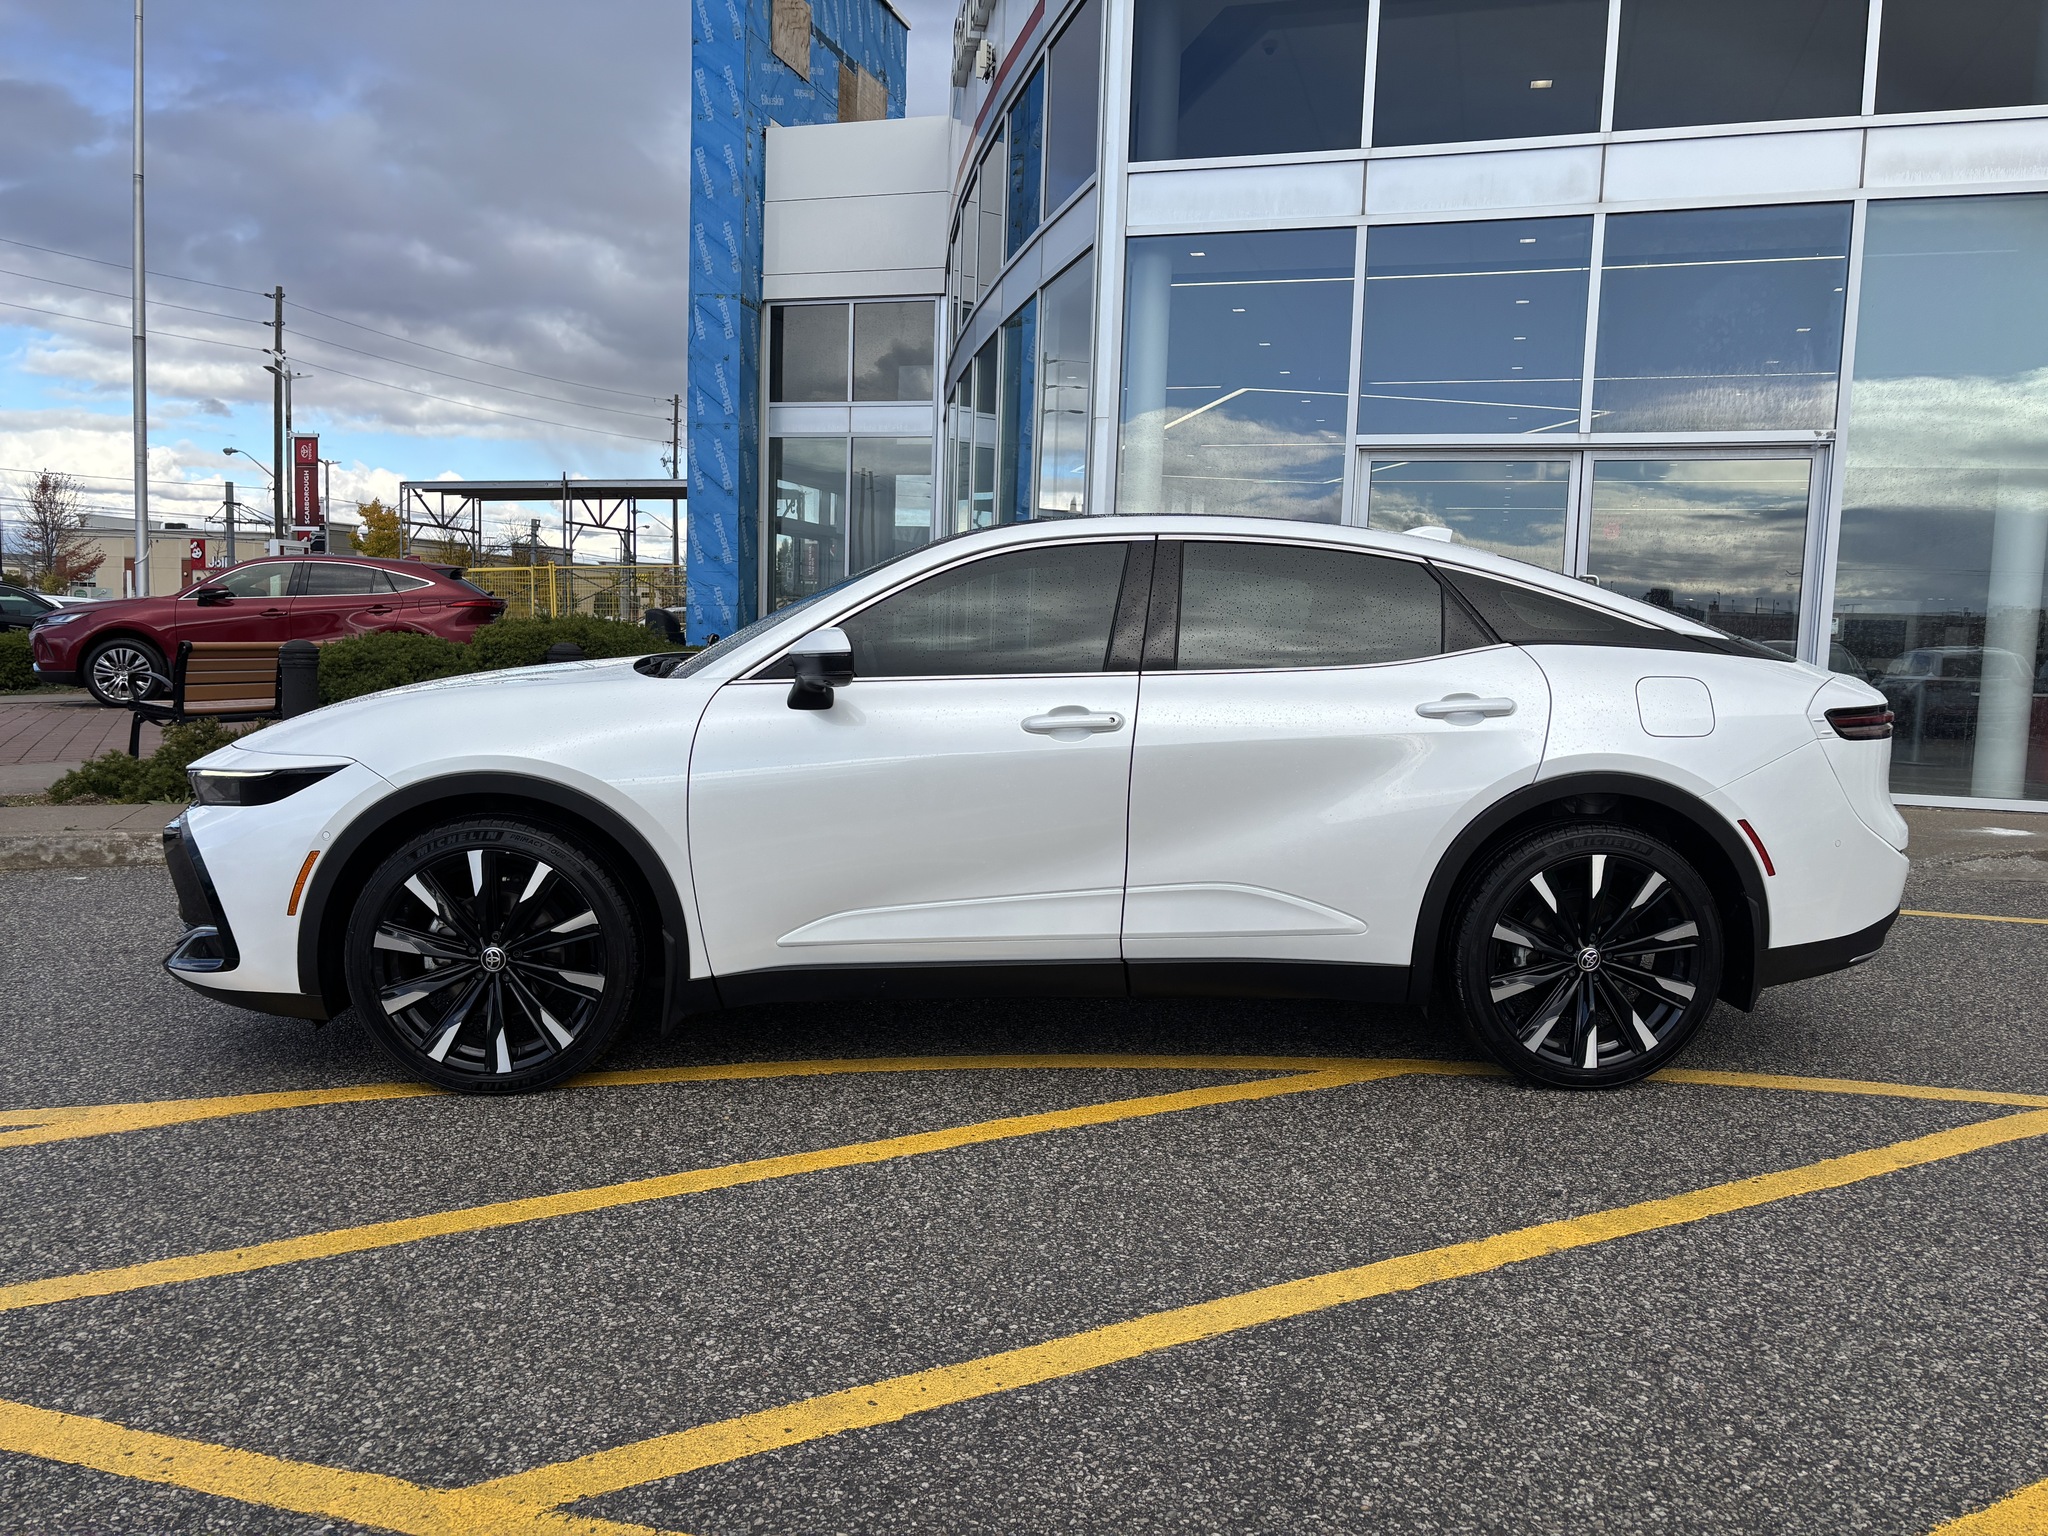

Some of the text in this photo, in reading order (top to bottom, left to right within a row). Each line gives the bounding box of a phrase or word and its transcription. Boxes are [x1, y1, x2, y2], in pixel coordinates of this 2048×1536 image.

[695, 0, 714, 42] lueskin
[695, 68, 713, 121] Blueskin
[724, 65, 741, 118] Blueskin
[761, 94, 784, 105] Blueskin
[694, 146, 713, 199] Blueskin
[723, 144, 742, 197] Blueskin
[694, 222, 713, 275] Blueskin
[723, 221, 741, 274] Blueskin
[714, 363, 734, 416] Blueskin
[714, 438, 733, 490] Blueskin
[713, 513, 732, 564] Blueskin
[417, 831, 498, 857] MICHELIN
[510, 834, 566, 859] PRIMACY TOUR
